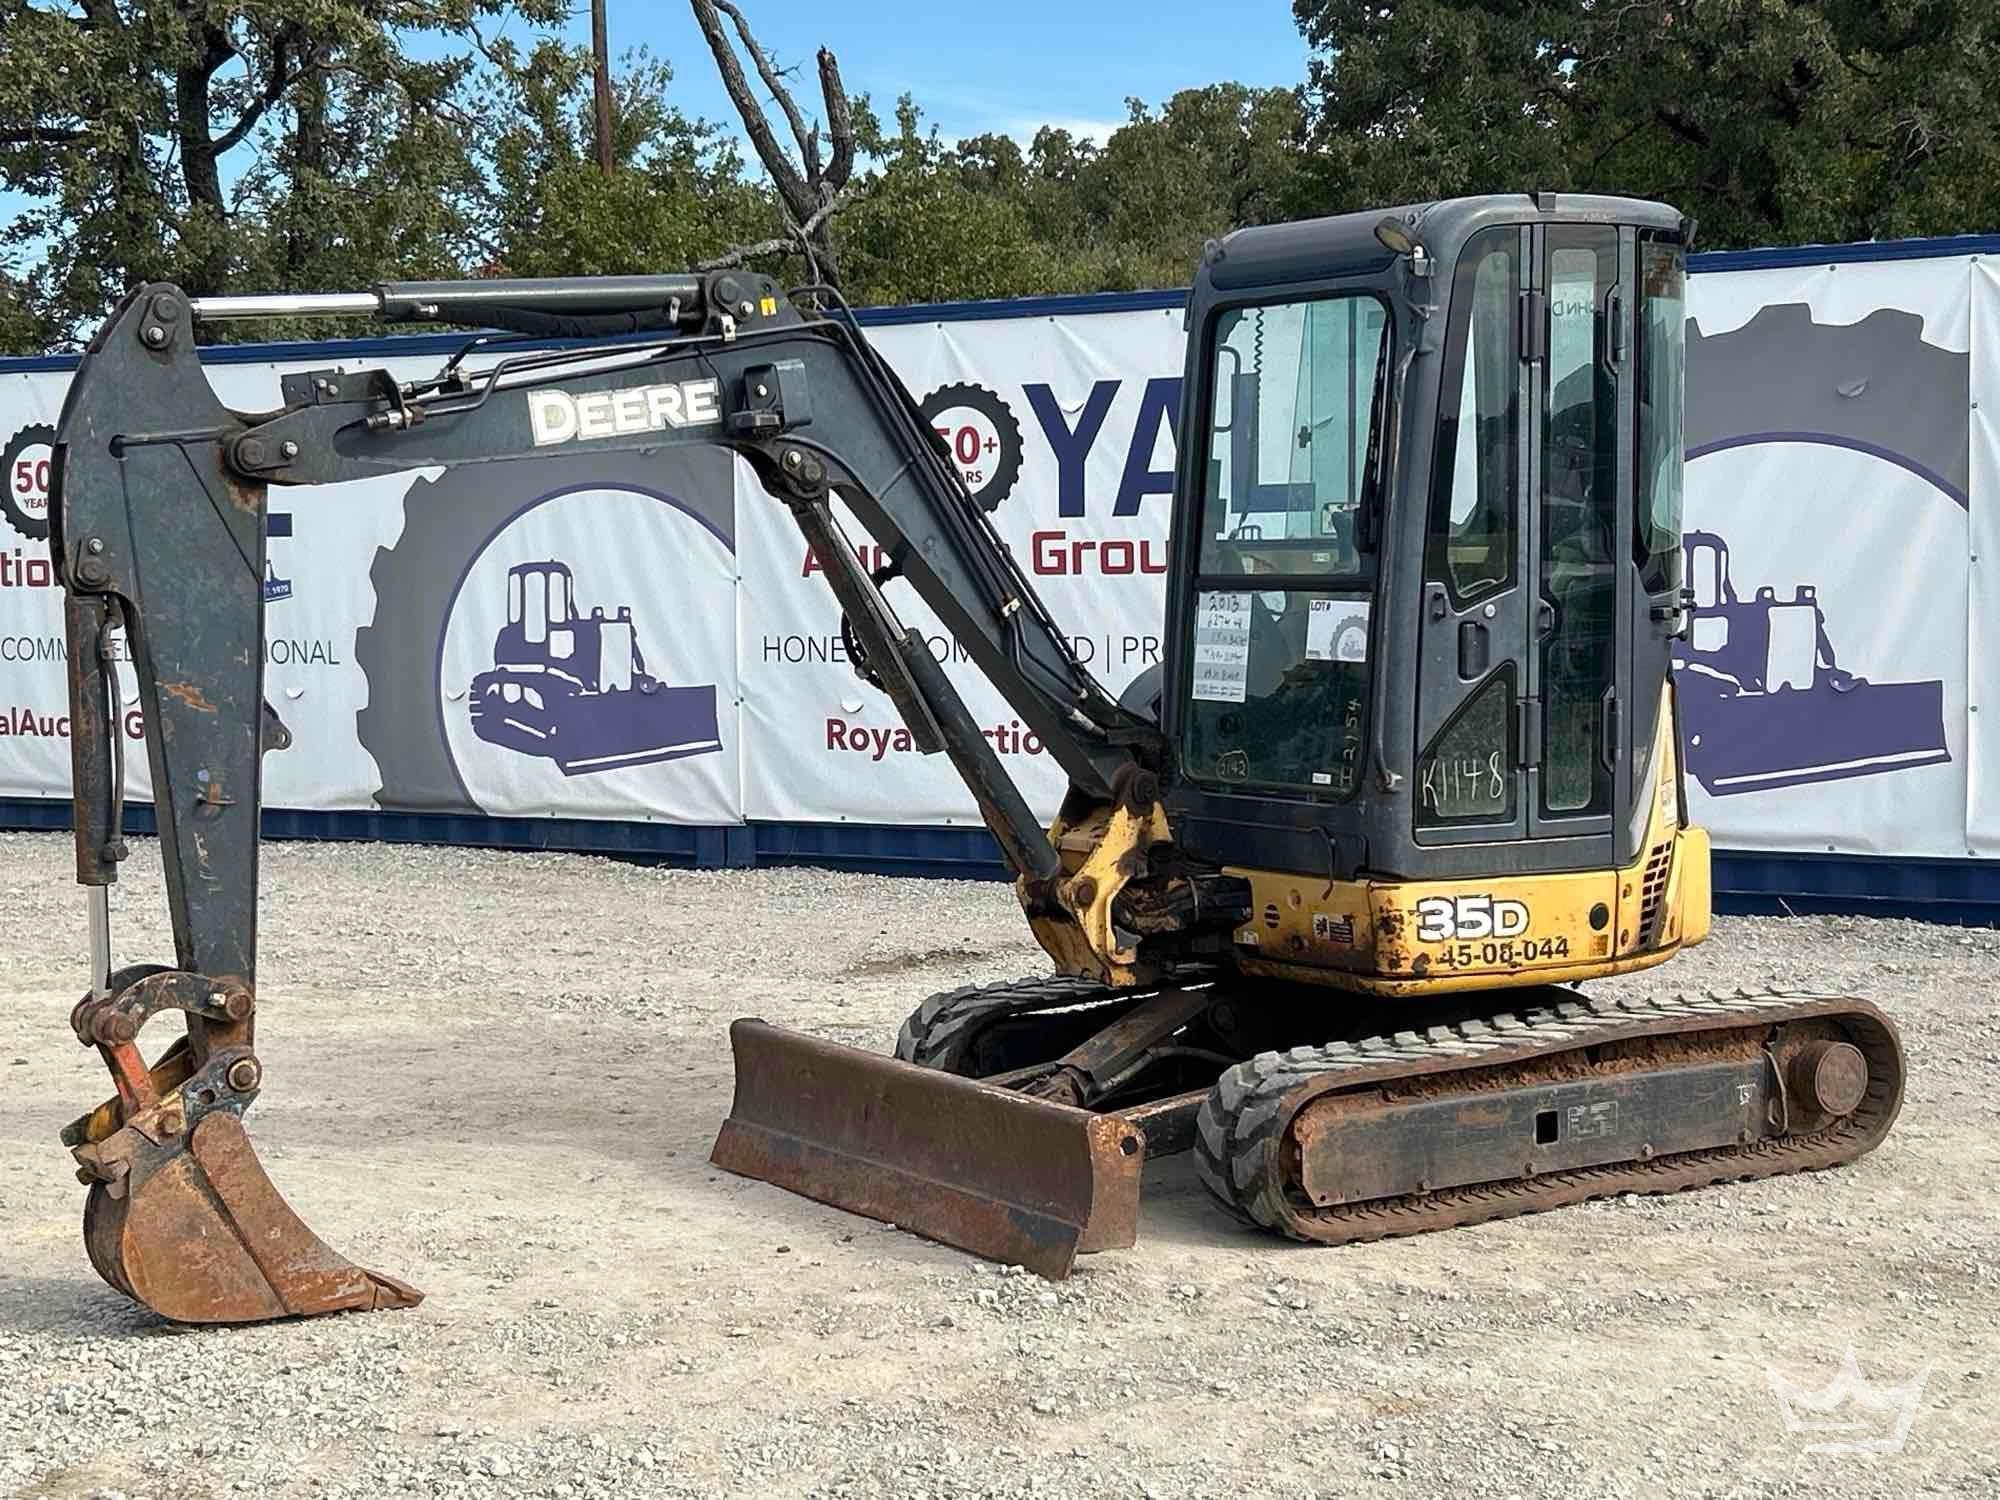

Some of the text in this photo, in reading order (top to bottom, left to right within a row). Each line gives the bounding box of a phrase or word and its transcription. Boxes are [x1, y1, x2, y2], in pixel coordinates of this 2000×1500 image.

[527, 377, 722, 447] DEERE
[763, 635, 845, 664] HONE
[1122, 636, 1163, 665] PR
[1422, 751, 1504, 807] K1148
[1416, 894, 1530, 942] 35D
